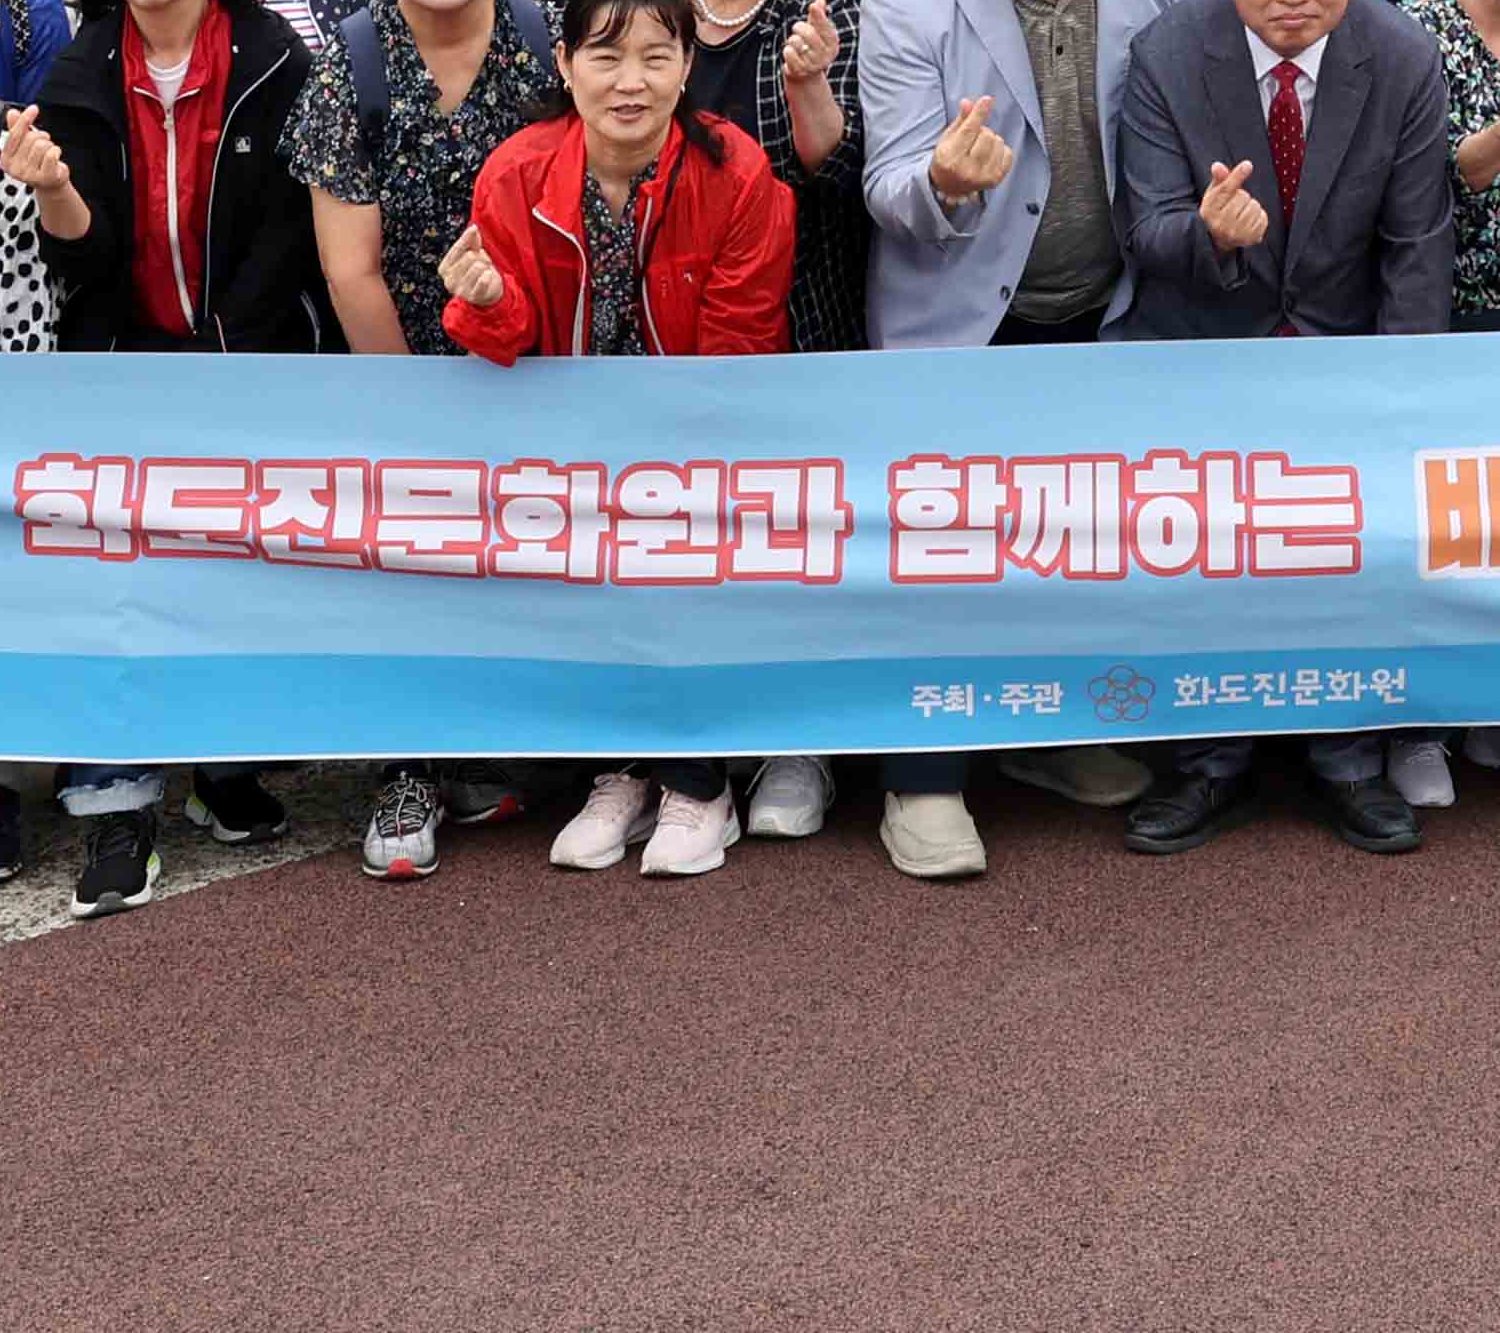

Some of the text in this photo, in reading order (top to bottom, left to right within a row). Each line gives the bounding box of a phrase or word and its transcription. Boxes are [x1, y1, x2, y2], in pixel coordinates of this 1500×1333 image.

[15, 453, 853, 586] 화도진문화원과
[889, 450, 1362, 585] 함께하는
[1173, 667, 1407, 710] 화도진문화원
